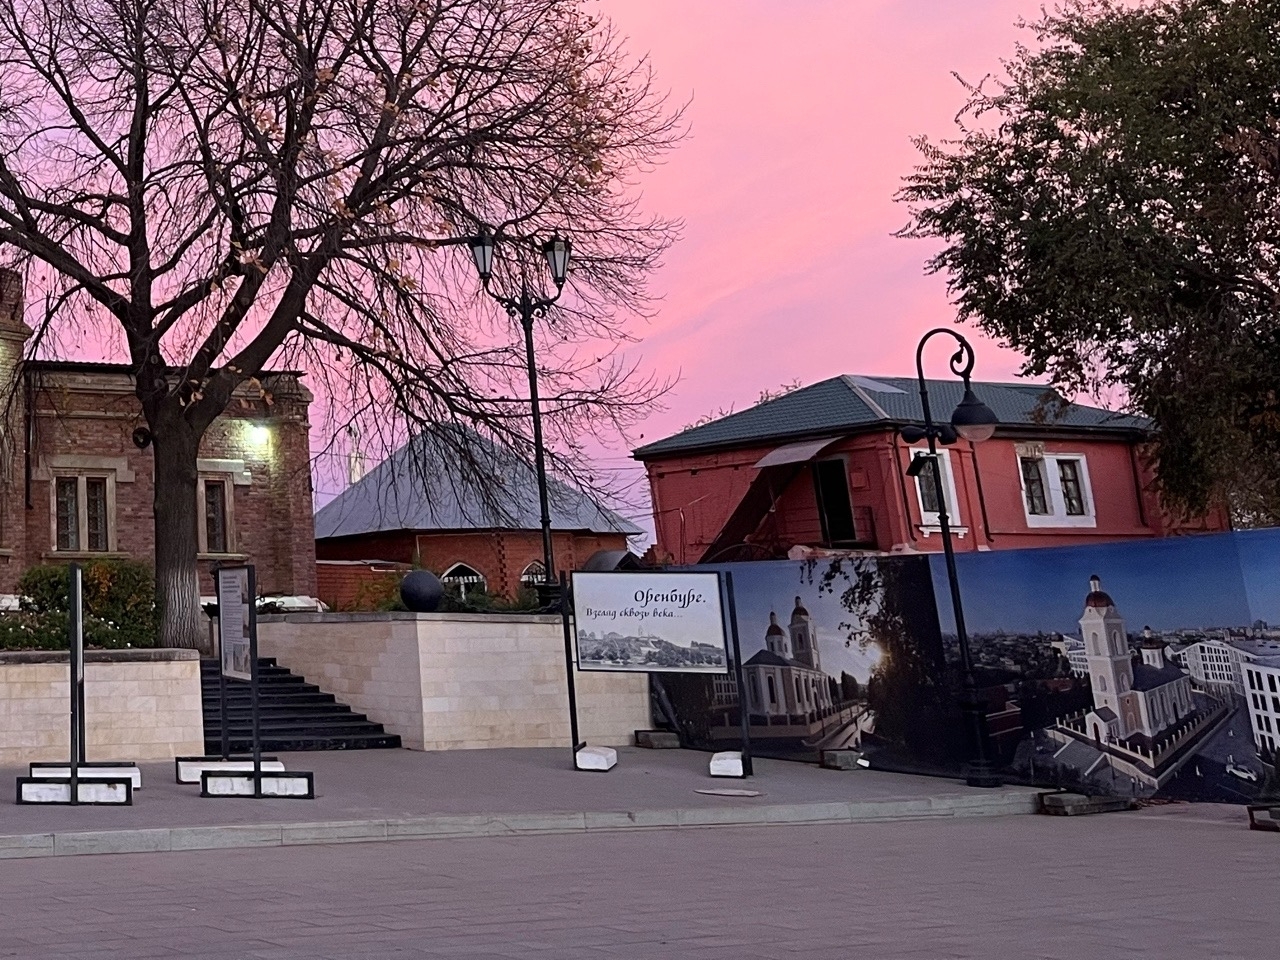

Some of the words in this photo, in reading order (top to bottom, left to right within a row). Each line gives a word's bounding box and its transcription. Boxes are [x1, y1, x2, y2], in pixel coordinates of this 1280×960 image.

[634, 588, 706, 608] Оренбург.
[586, 608, 617, 620] Взгляд
[619, 607, 650, 620] сквозь
